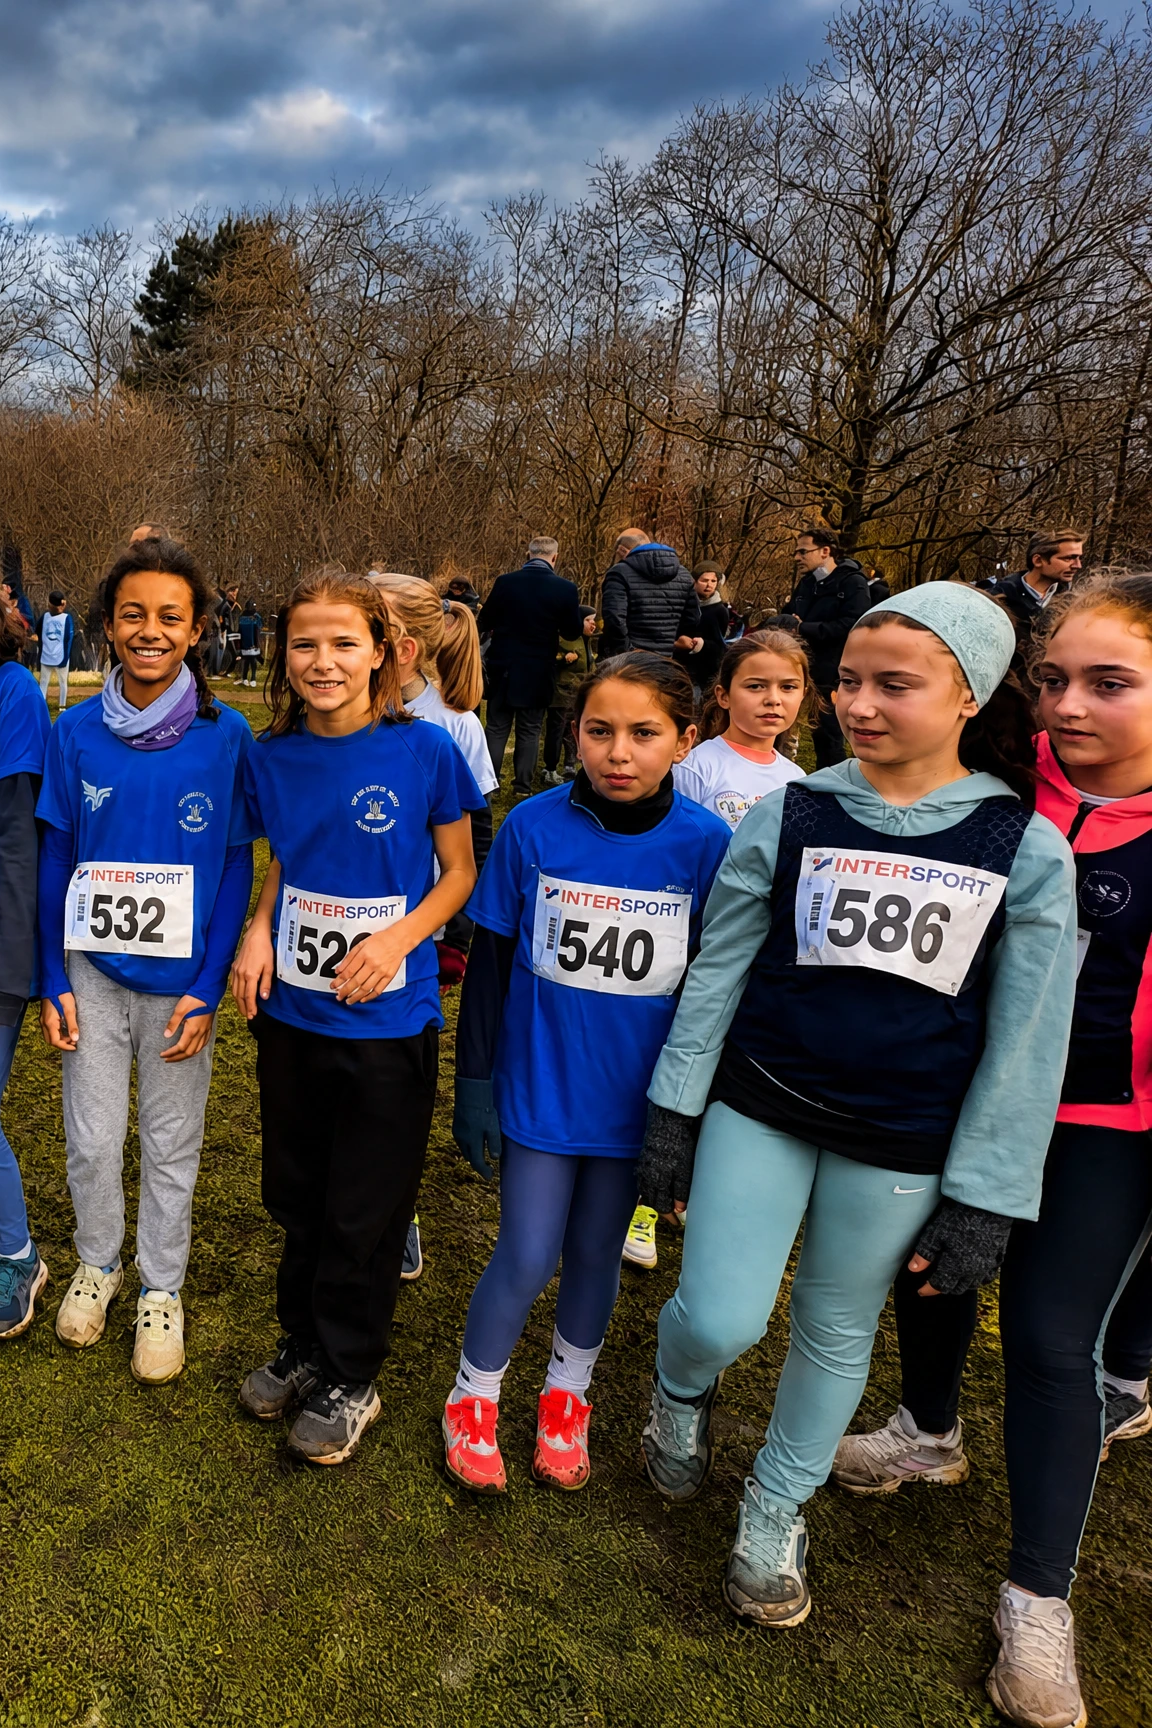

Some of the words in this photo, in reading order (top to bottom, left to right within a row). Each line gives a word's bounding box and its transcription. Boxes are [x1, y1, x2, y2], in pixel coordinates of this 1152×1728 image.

[91, 869, 183, 884] INTERSPORT
[832, 857, 991, 897] INTERSPORT
[90, 893, 166, 943] 532
[298, 898, 397, 919] INTERSPORT
[560, 889, 681, 917] INTERSPORT
[827, 888, 951, 964] 586
[296, 924, 373, 979] 52
[557, 918, 655, 982] 540
